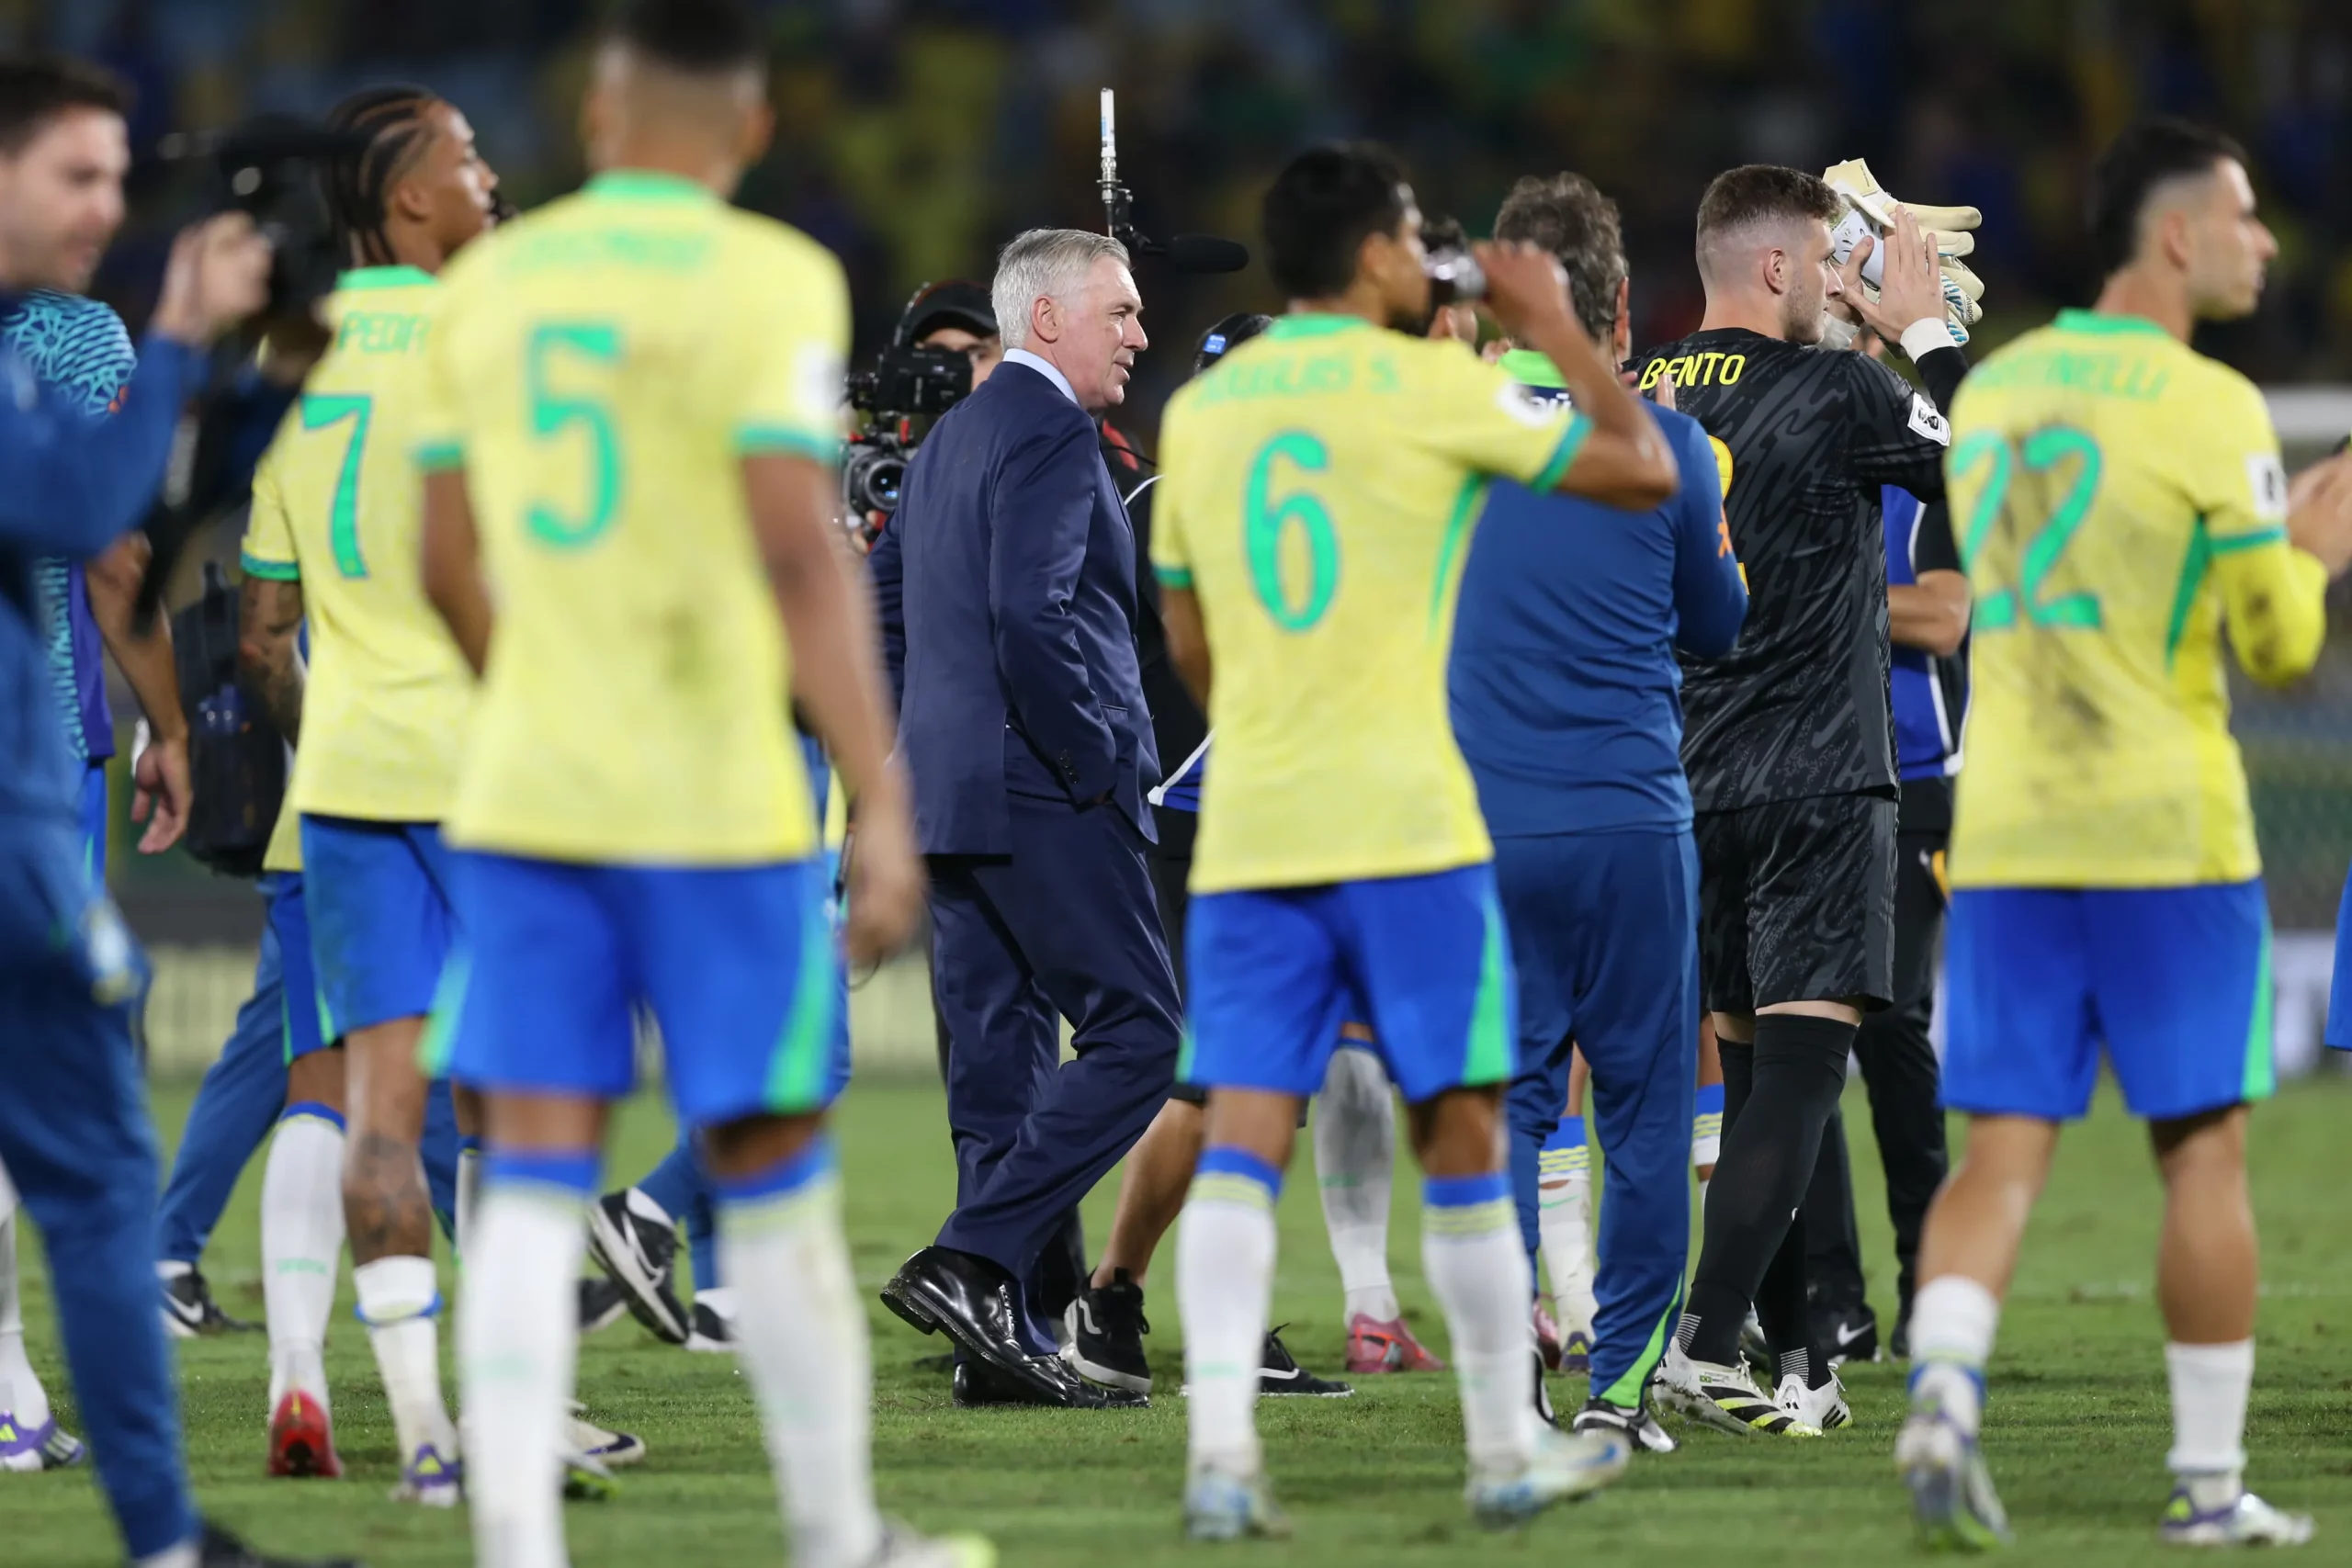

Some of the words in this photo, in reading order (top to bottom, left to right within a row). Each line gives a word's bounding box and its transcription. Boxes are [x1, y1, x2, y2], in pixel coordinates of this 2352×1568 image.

[339, 310, 432, 355] PEDR
[1638, 352, 1746, 390] BENTO
[299, 394, 371, 577] 7
[526, 320, 621, 551] 5
[1245, 428, 1340, 630] 6
[1950, 426, 2104, 631] 22
